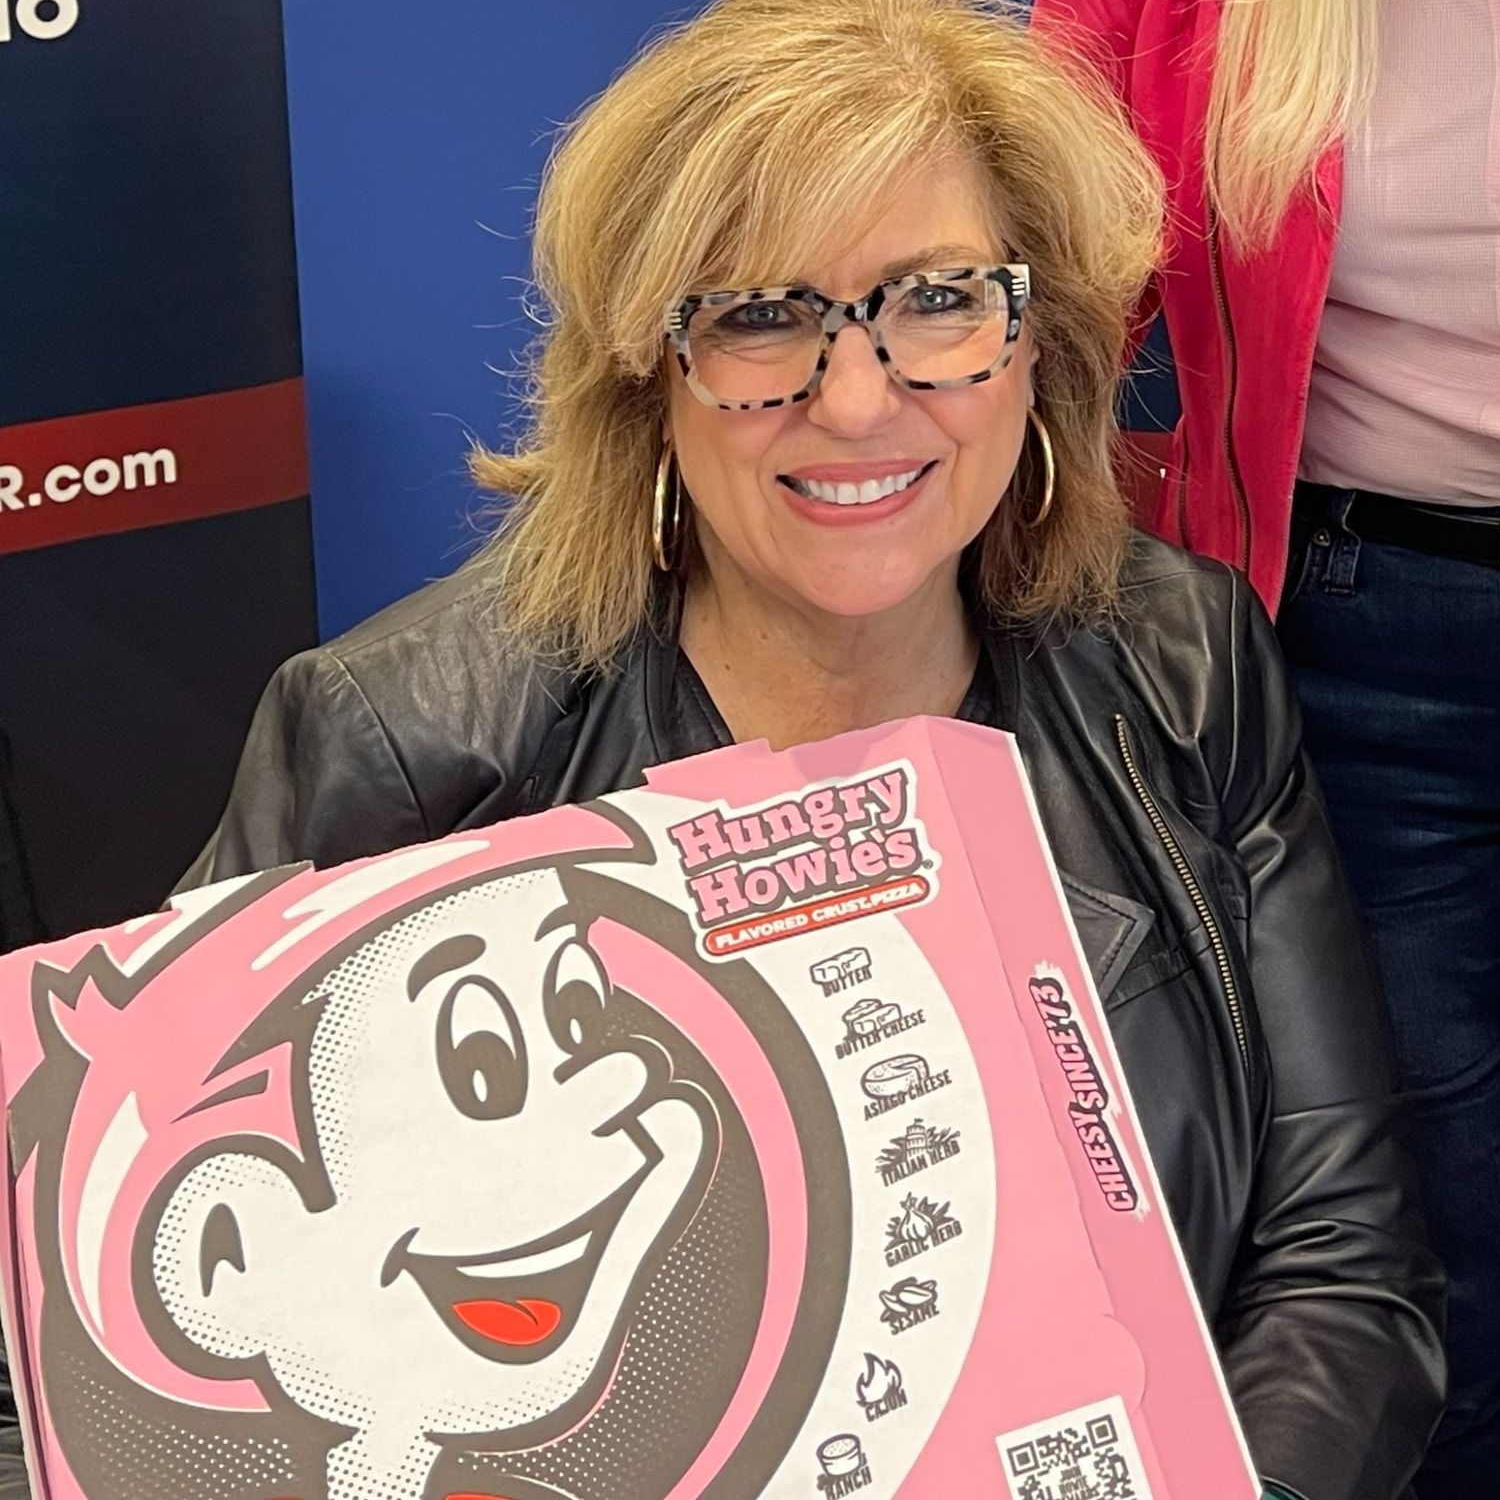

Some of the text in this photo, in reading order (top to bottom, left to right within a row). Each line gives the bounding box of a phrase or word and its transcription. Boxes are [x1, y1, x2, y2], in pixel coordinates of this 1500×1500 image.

[669, 771, 905, 870] Hungry
[689, 827, 919, 923] Howie's
[715, 905, 809, 949] FLAVORED
[822, 966, 872, 998] BUTTER
[835, 1009, 926, 1060] BUTTER CHEESE
[907, 1069, 952, 1099] CHEESE
[1048, 1020, 1108, 1111] SINCE
[881, 1155, 929, 1188] ITALIAN
[1069, 1101, 1138, 1212] CHEESY
[884, 1238, 930, 1268] GARLIC
[890, 1302, 940, 1335] SESAME
[865, 1389, 908, 1422] CAJUN
